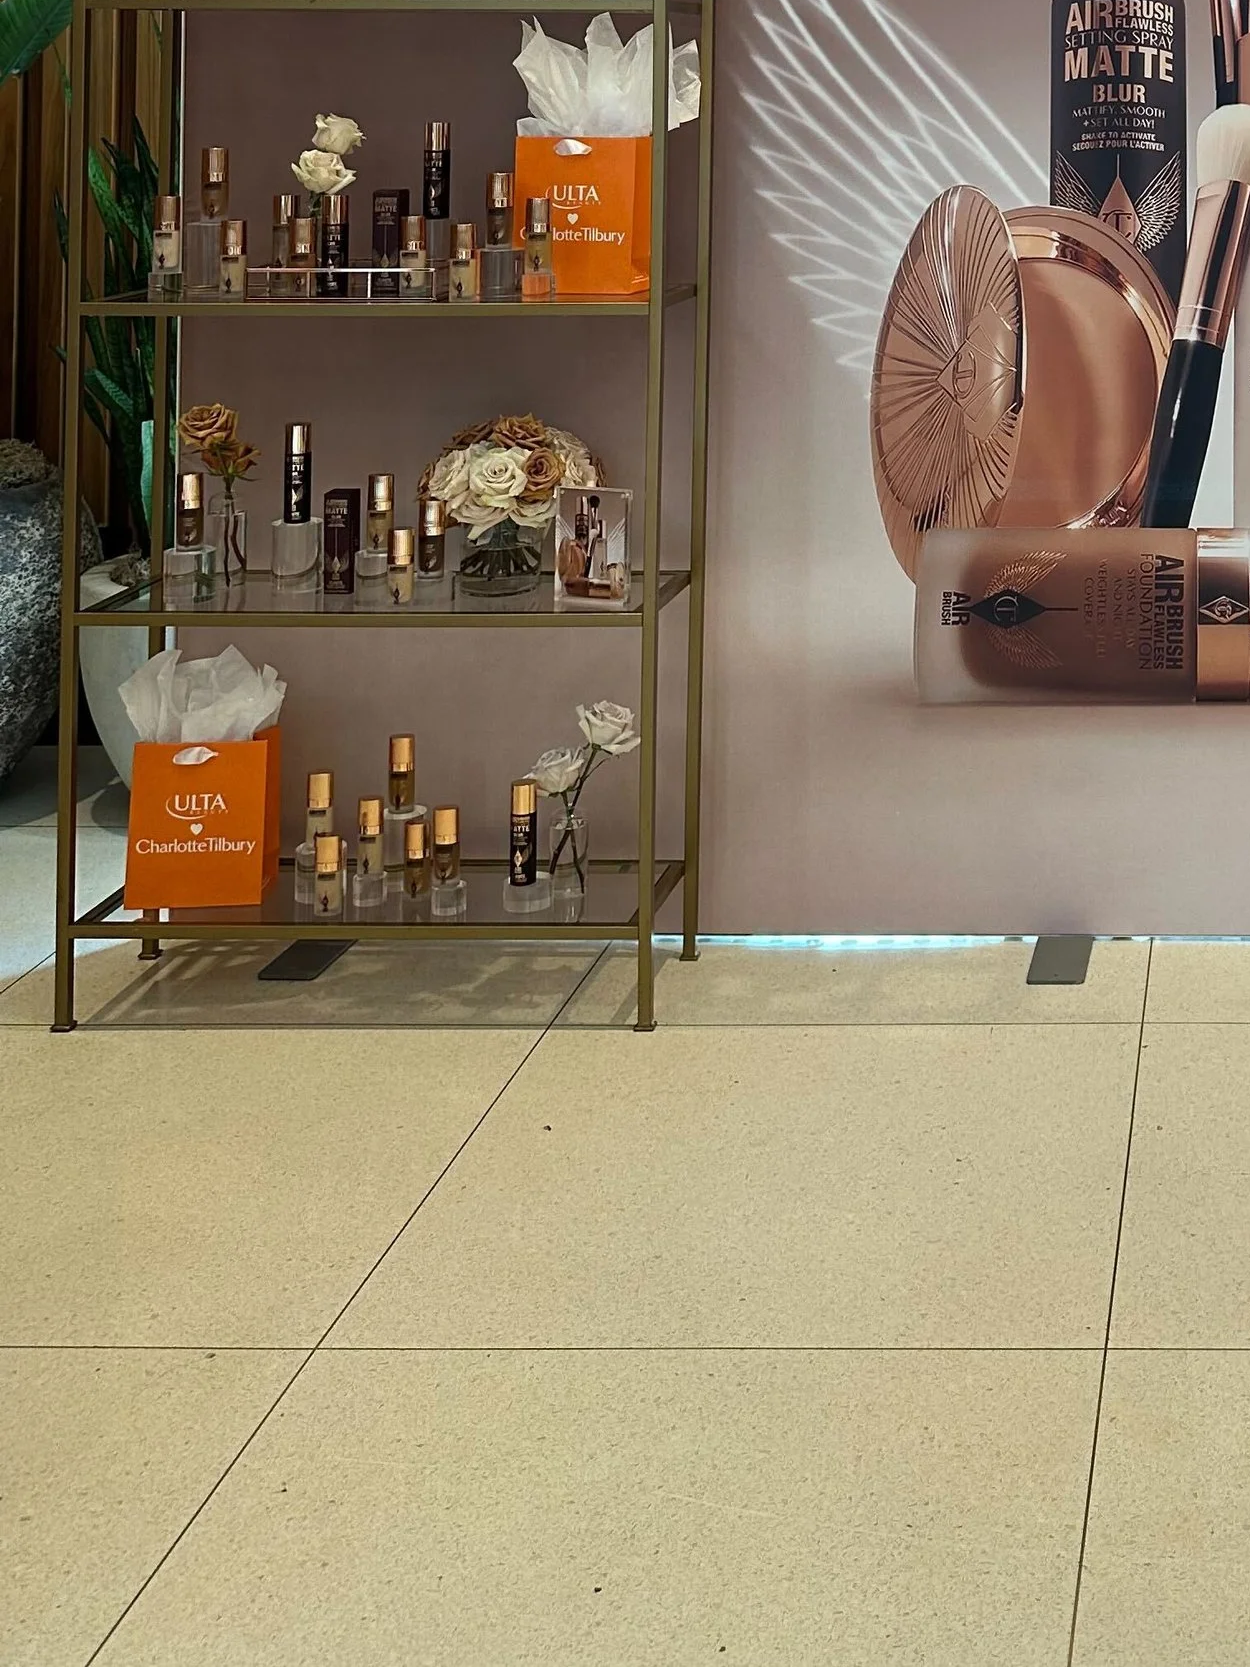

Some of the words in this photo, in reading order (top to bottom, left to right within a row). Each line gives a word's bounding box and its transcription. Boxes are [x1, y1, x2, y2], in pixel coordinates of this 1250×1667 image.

[1115, 17, 1174, 36] FLAWLESS
[1065, 30, 1127, 50] SETTING
[1132, 31, 1174, 50] SPRAY
[1064, 44, 1174, 83] MATTE
[1093, 84, 1146, 103] BLUR
[1120, 105, 1166, 119] SMOOTH
[1112, 117, 1130, 127] ALL
[1106, 140, 1128, 148] POUR
[1108, 131, 1119, 139] TO
[1121, 132, 1156, 142] ACTIVATE
[553, 184, 599, 201] ULTA
[1126, 568, 1137, 602] STAYS
[941, 591, 952, 626] BRUSH
[951, 591, 971, 626] AIR
[1139, 553, 1154, 670] FOUNDATION
[1153, 604, 1165, 669] FLAWLESS
[174, 793, 226, 811] ULTA
